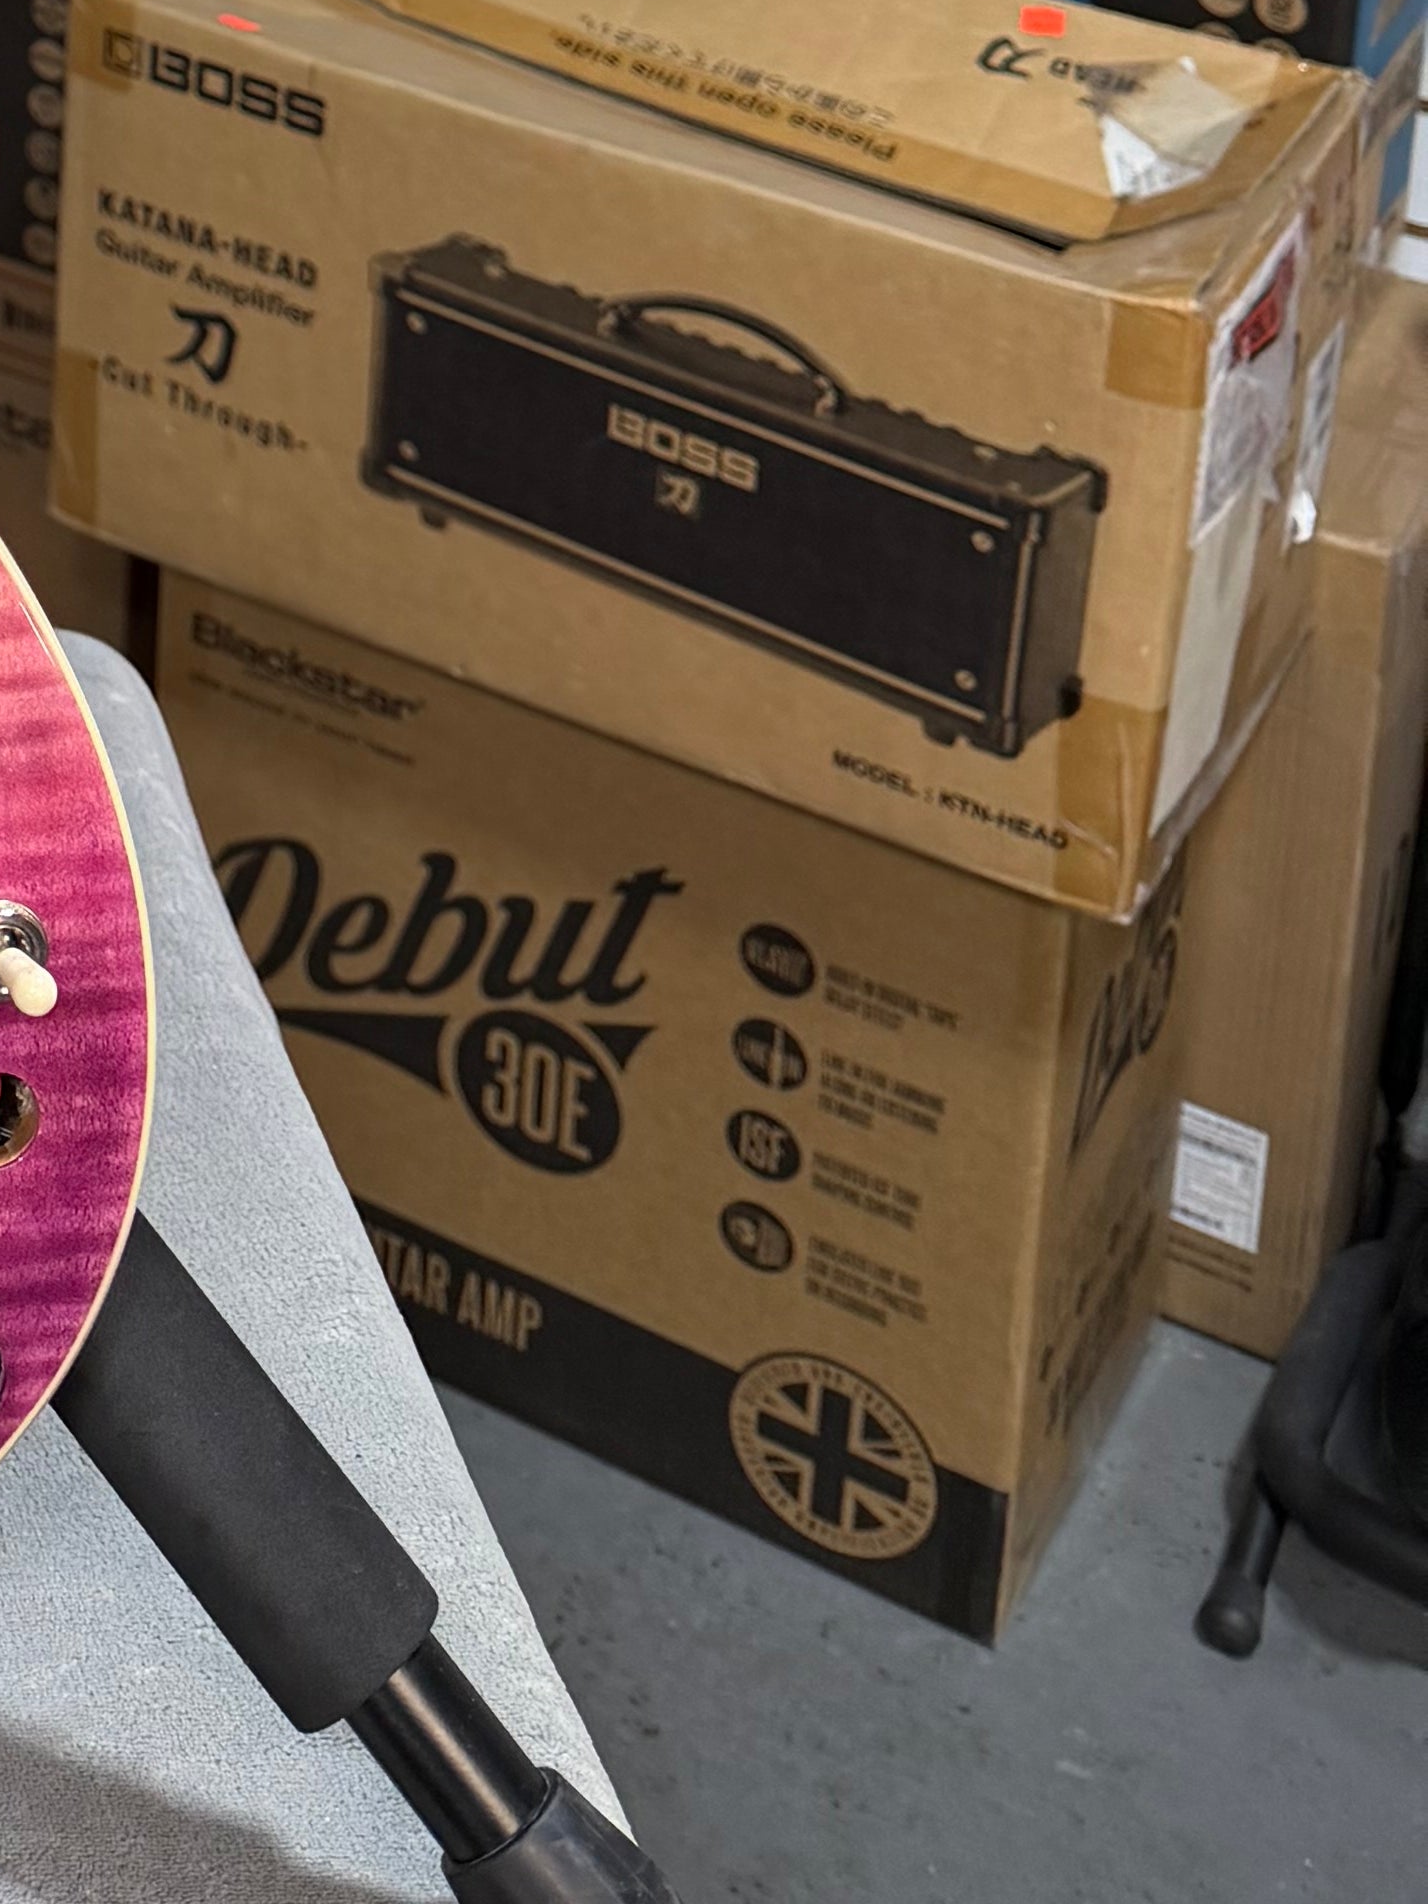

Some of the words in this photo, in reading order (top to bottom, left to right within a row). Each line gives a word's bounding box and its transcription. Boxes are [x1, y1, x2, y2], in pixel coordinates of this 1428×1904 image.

[147, 38, 328, 138] BOSS
[628, 61, 690, 94] this
[696, 81, 781, 120] open
[787, 109, 899, 165] Please
[95, 226, 179, 280] Guitar
[185, 261, 316, 329] Amplifier
[96, 187, 319, 290] KATANA-HEAD
[605, 402, 761, 493] BOSS
[191, 610, 426, 721] Blackstar
[832, 748, 920, 798] MODEL
[937, 790, 1069, 850] KTN-HEAD
[212, 835, 687, 1006] Debut
[481, 1026, 596, 1163] 30E
[455, 1270, 544, 1352] AMP
